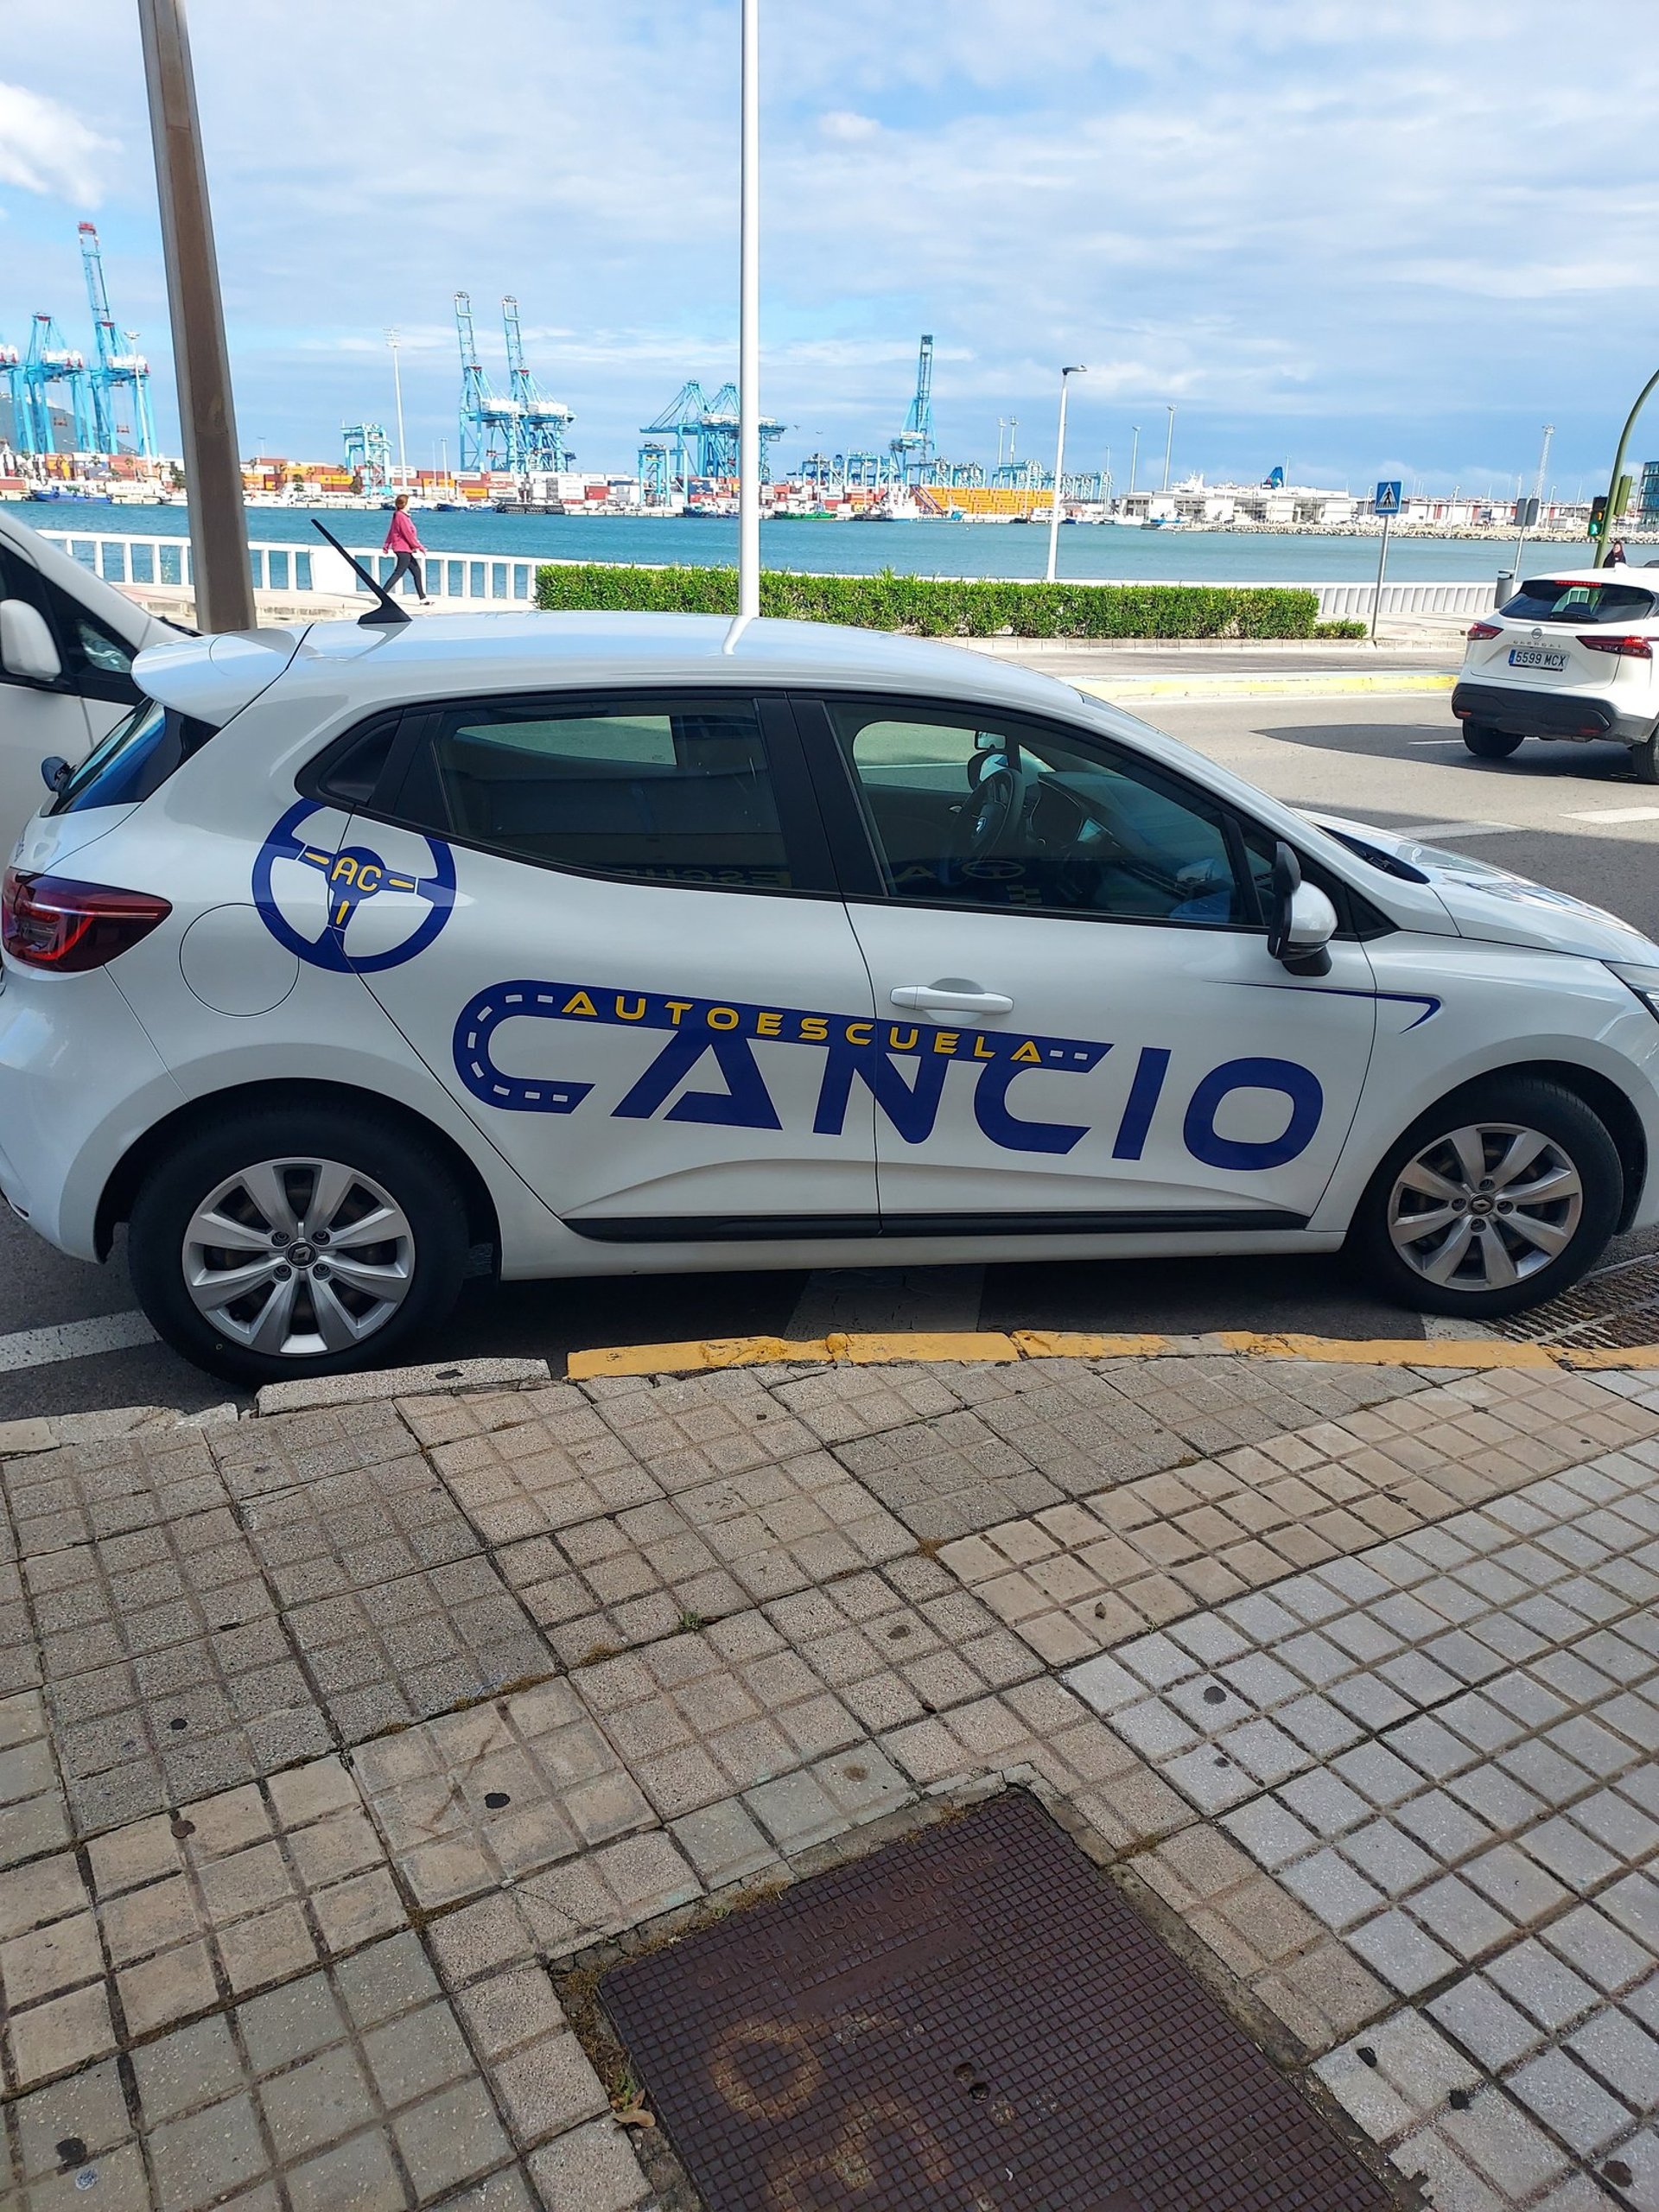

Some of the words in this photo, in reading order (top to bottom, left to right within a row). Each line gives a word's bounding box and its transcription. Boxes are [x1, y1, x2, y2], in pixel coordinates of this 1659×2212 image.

[1516, 652, 1542, 664] 5599
[1544, 653, 1567, 667] MCX
[330, 856, 382, 892] AC
[561, 990, 1042, 1064] AUTOESCUELA
[452, 978, 1324, 1171] CANCIO
